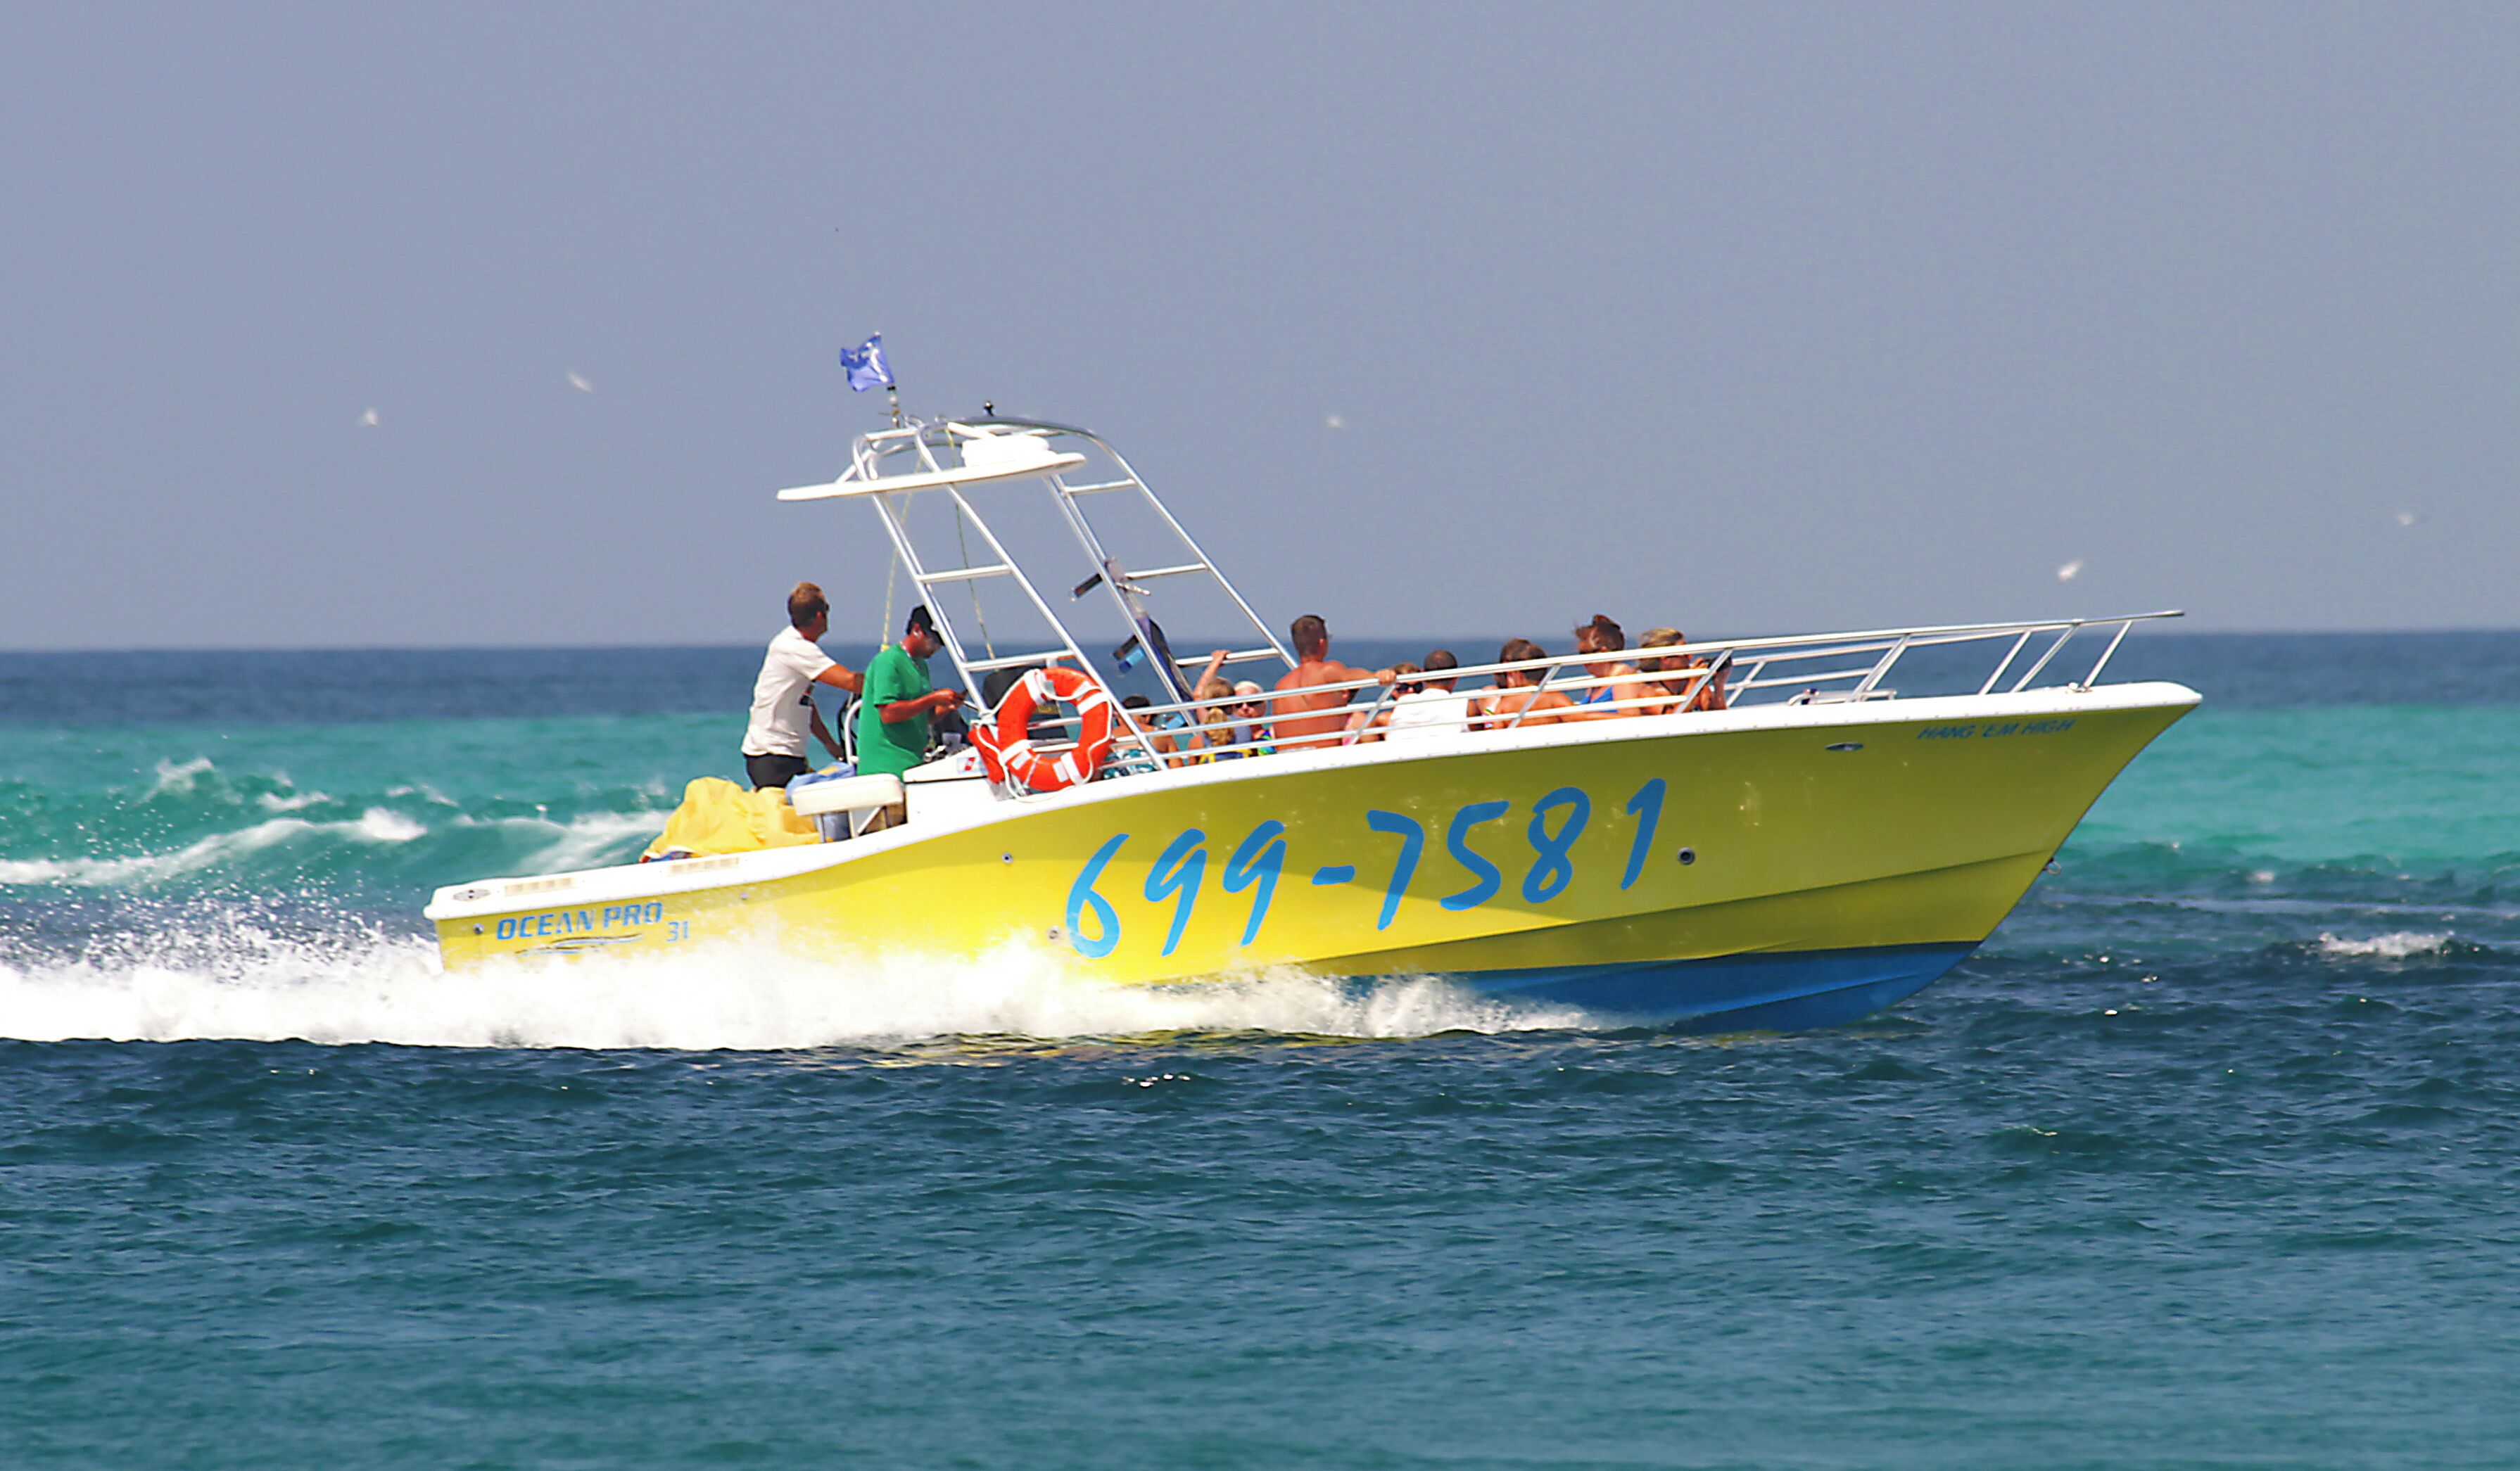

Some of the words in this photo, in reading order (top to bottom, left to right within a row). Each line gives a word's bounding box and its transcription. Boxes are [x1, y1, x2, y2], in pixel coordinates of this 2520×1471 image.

[1918, 724, 1976, 739] HANG
[2020, 719, 2076, 734] HIGH
[1065, 777, 1667, 958] 699-7581
[496, 909, 595, 940] OCEAN
[603, 901, 664, 928] PRO
[666, 920, 689, 942] 31
